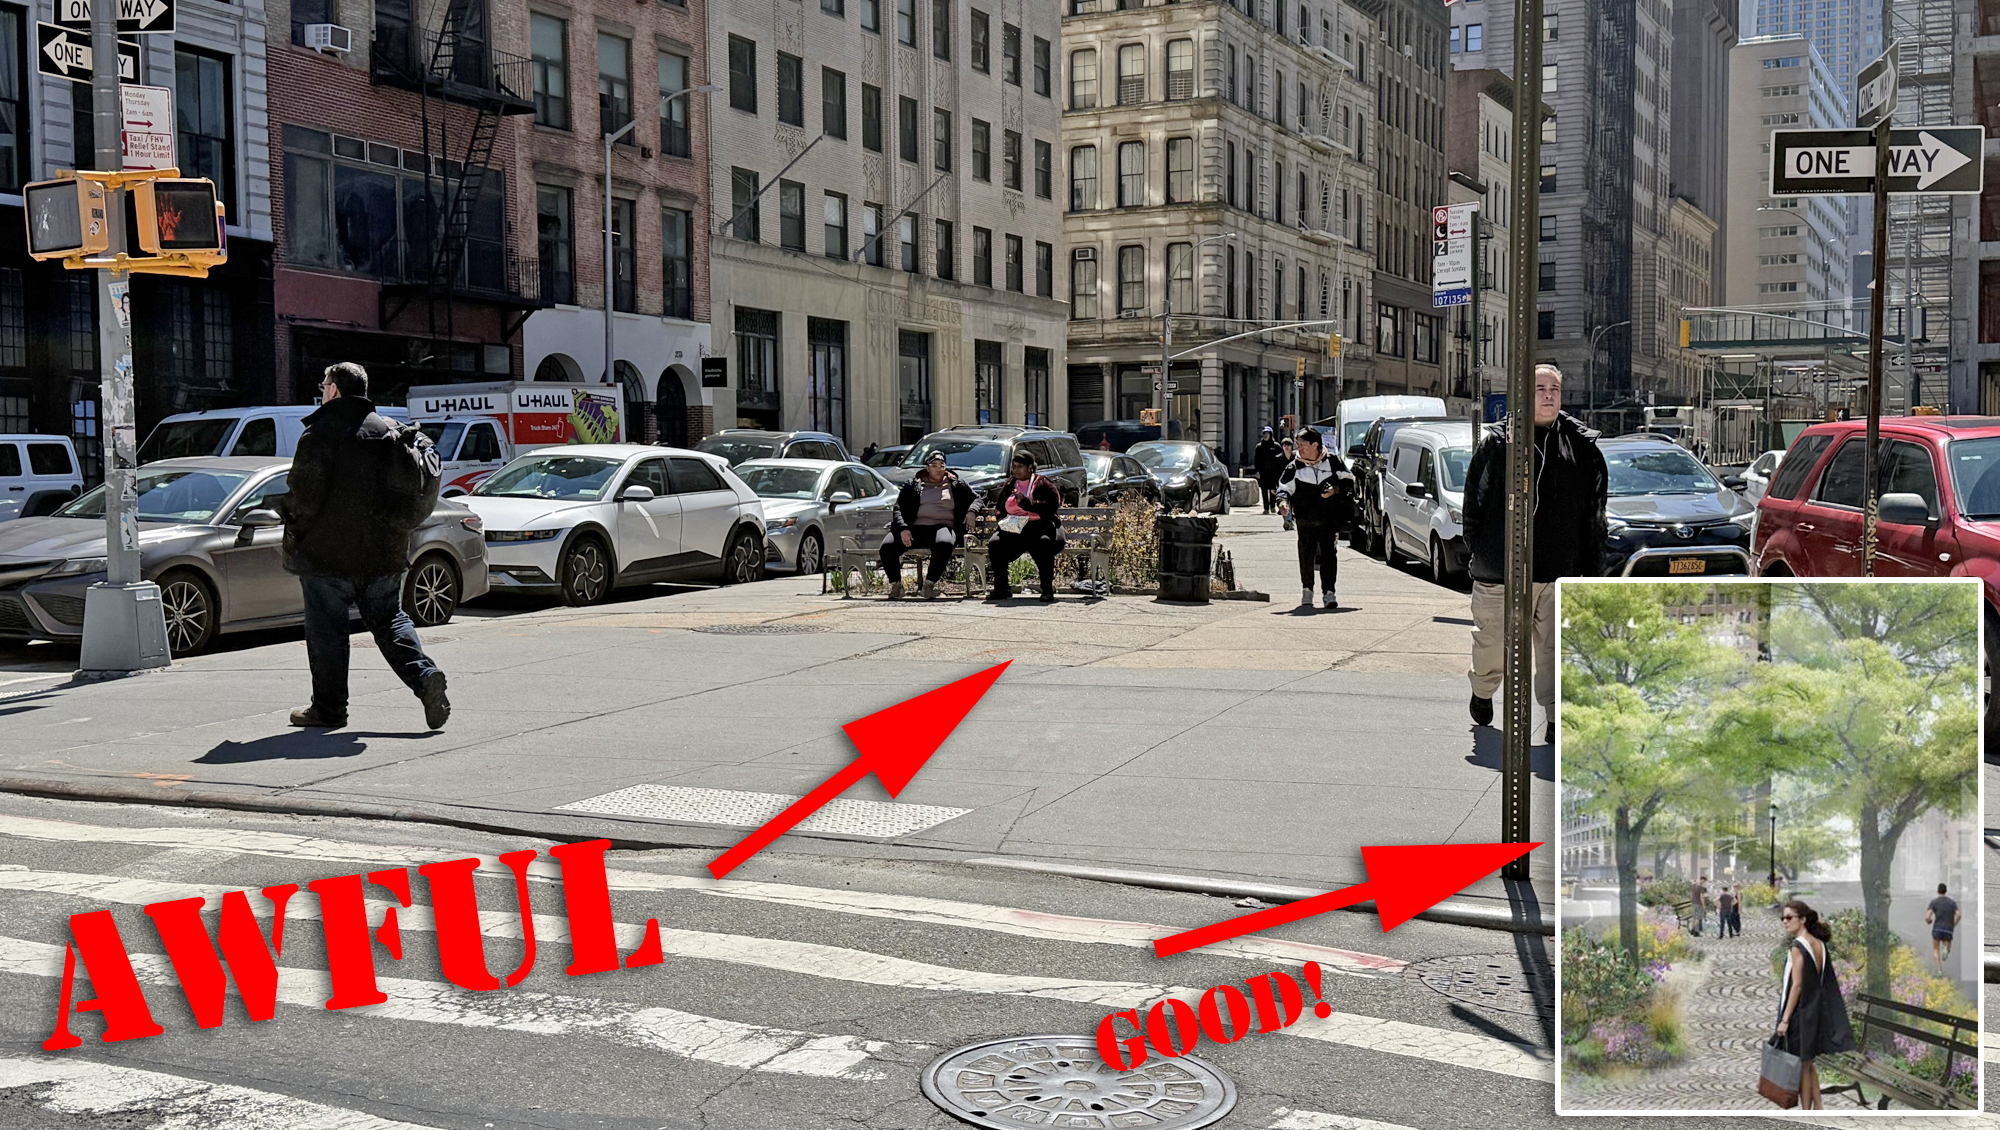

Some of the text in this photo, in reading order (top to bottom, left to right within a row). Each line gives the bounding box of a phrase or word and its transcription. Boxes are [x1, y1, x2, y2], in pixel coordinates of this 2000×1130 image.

[70, 0, 157, 18] ON WAY
[54, 42, 84, 66] ONE
[124, 91, 146, 99] Monday
[1861, 66, 1893, 114] ONE WAY
[125, 98, 150, 107] Thursday
[141, 109, 154, 117] 6am
[129, 134, 143, 142] Taxi
[150, 135, 164, 143] FHV
[129, 142, 170, 151] Relief Stand
[153, 151, 170, 159] Limit
[1796, 149, 1941, 175] ONE WAY
[1437, 241, 1446, 255] 2
[1434, 294, 1462, 306] 107135
[425, 396, 494, 413] U-HAUL
[518, 394, 569, 408] U-HAUL
